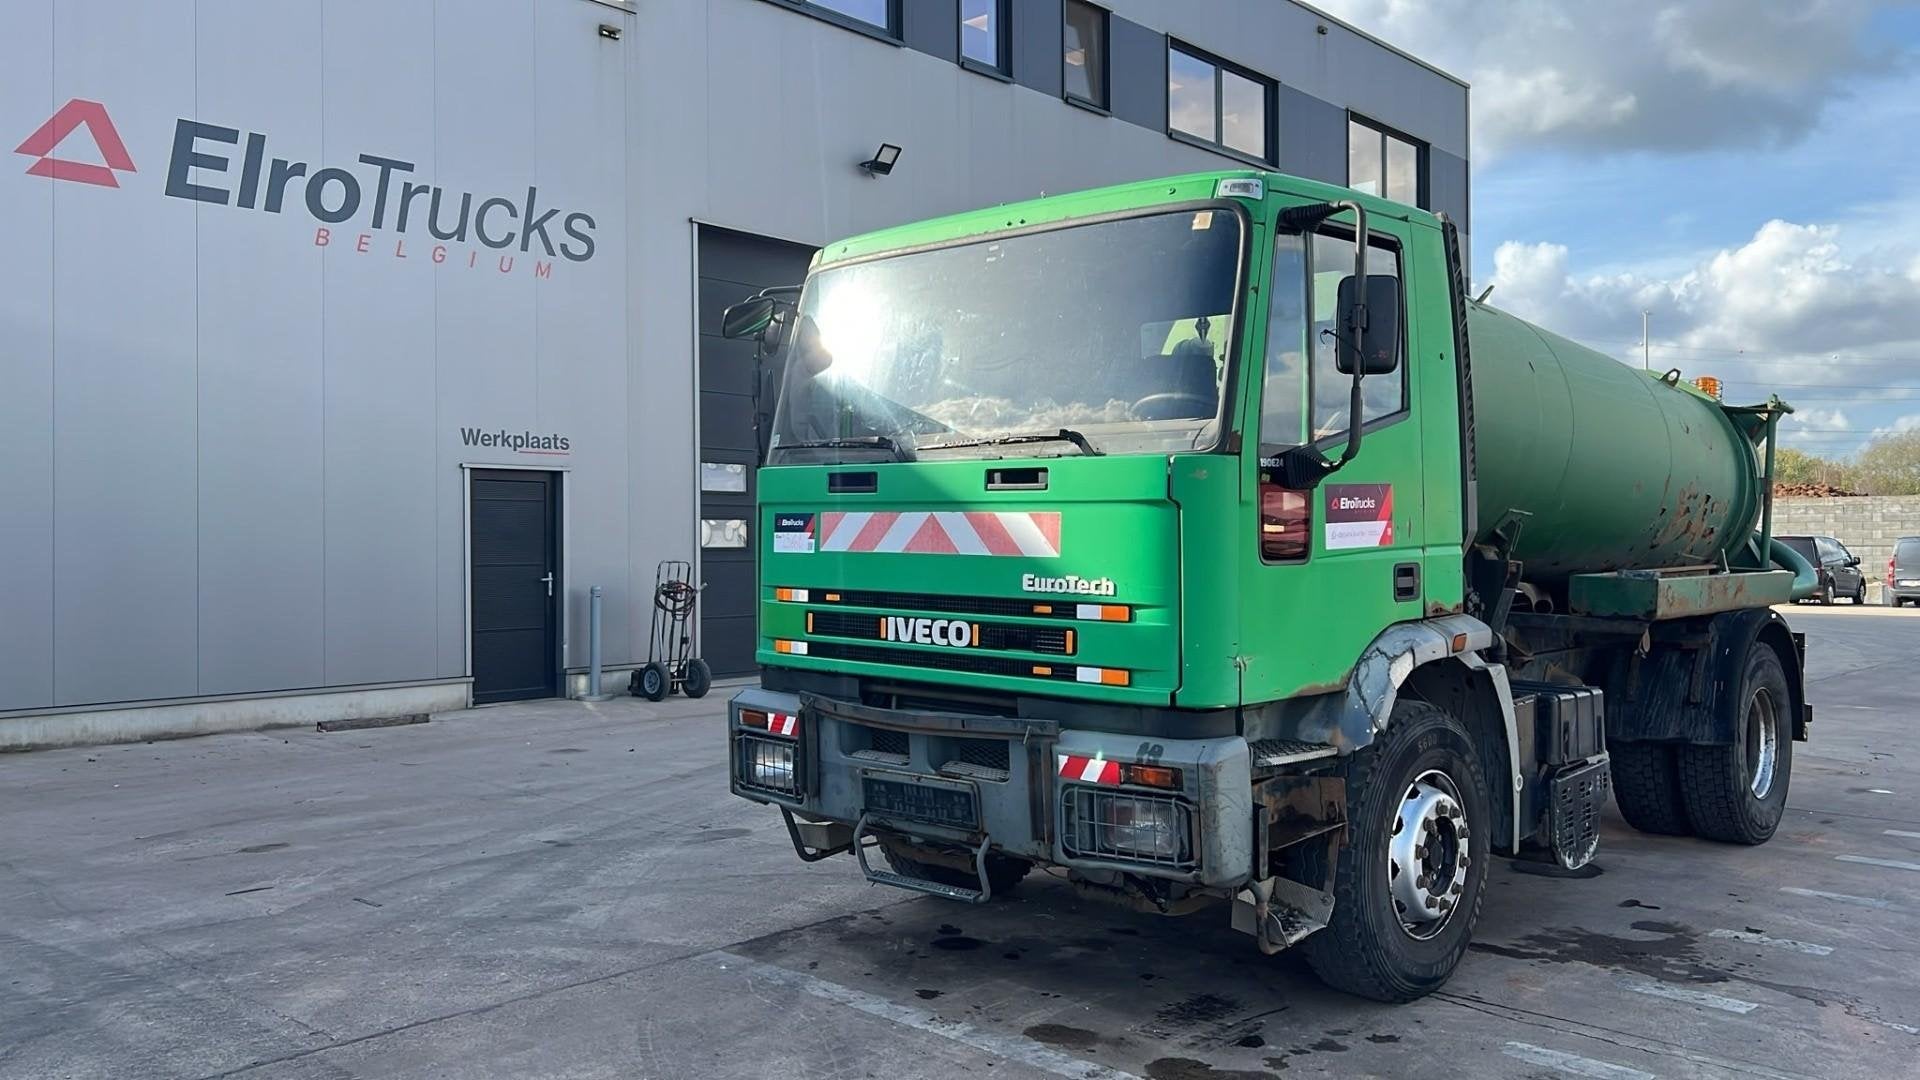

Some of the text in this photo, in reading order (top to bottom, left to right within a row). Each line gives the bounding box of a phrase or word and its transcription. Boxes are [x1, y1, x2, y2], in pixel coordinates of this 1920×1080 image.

[165, 118, 596, 262] ElroTrucks
[315, 228, 552, 279] BELGIUM
[460, 427, 570, 452] Werkplaats
[1340, 497, 1376, 509] ElroTrucks
[1022, 574, 1115, 596] EuroTech
[887, 616, 971, 647] IVECO
